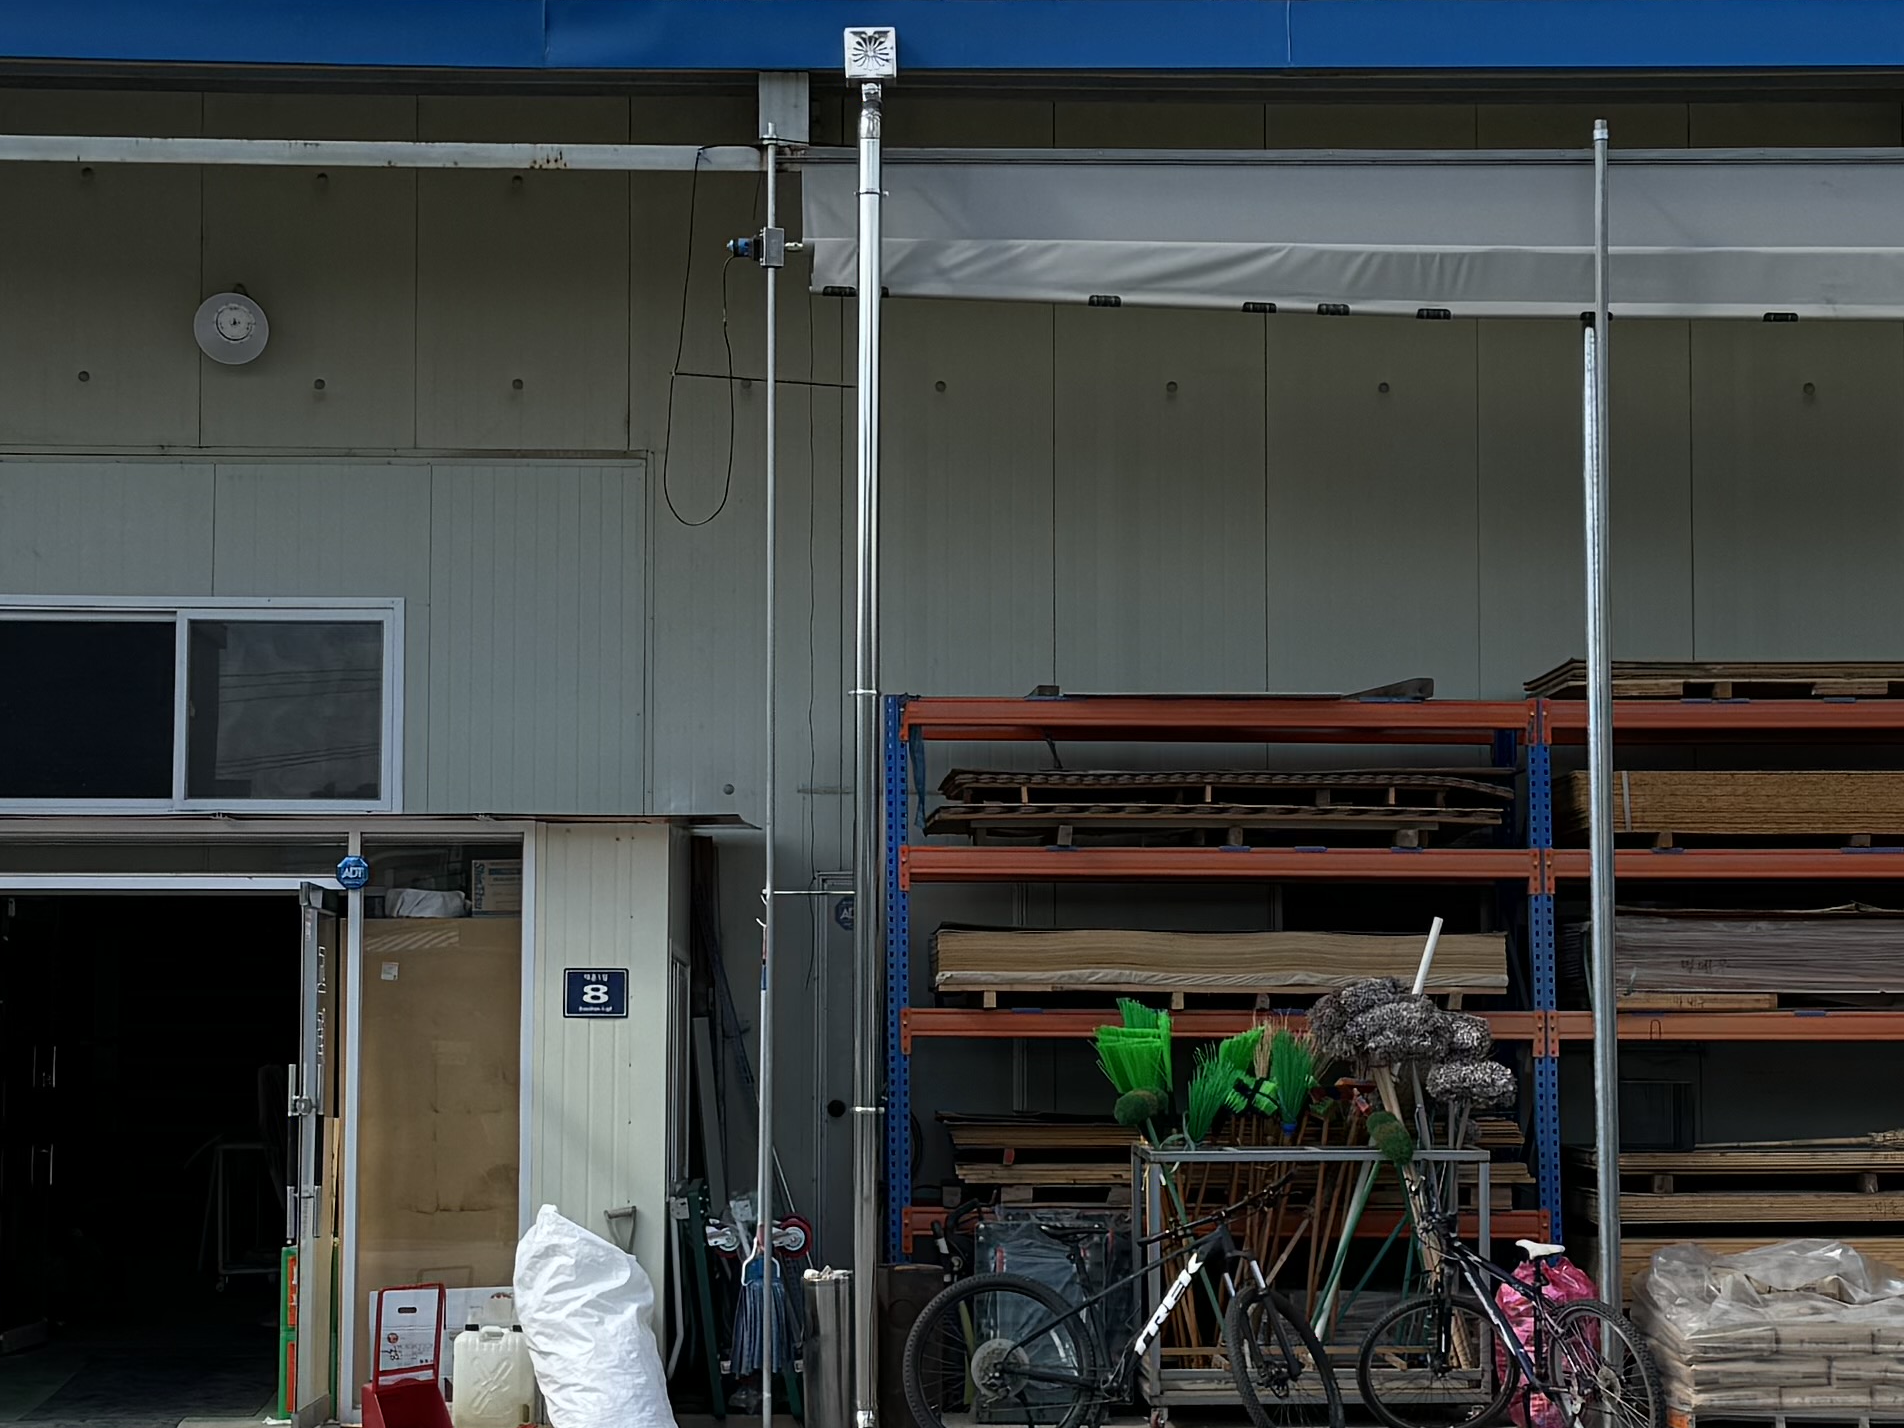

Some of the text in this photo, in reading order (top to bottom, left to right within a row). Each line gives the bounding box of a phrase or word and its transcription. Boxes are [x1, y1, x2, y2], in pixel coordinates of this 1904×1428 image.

[341, 867, 365, 879] ADT
[582, 984, 609, 1004] 8
[1134, 1252, 1204, 1356] TREK
